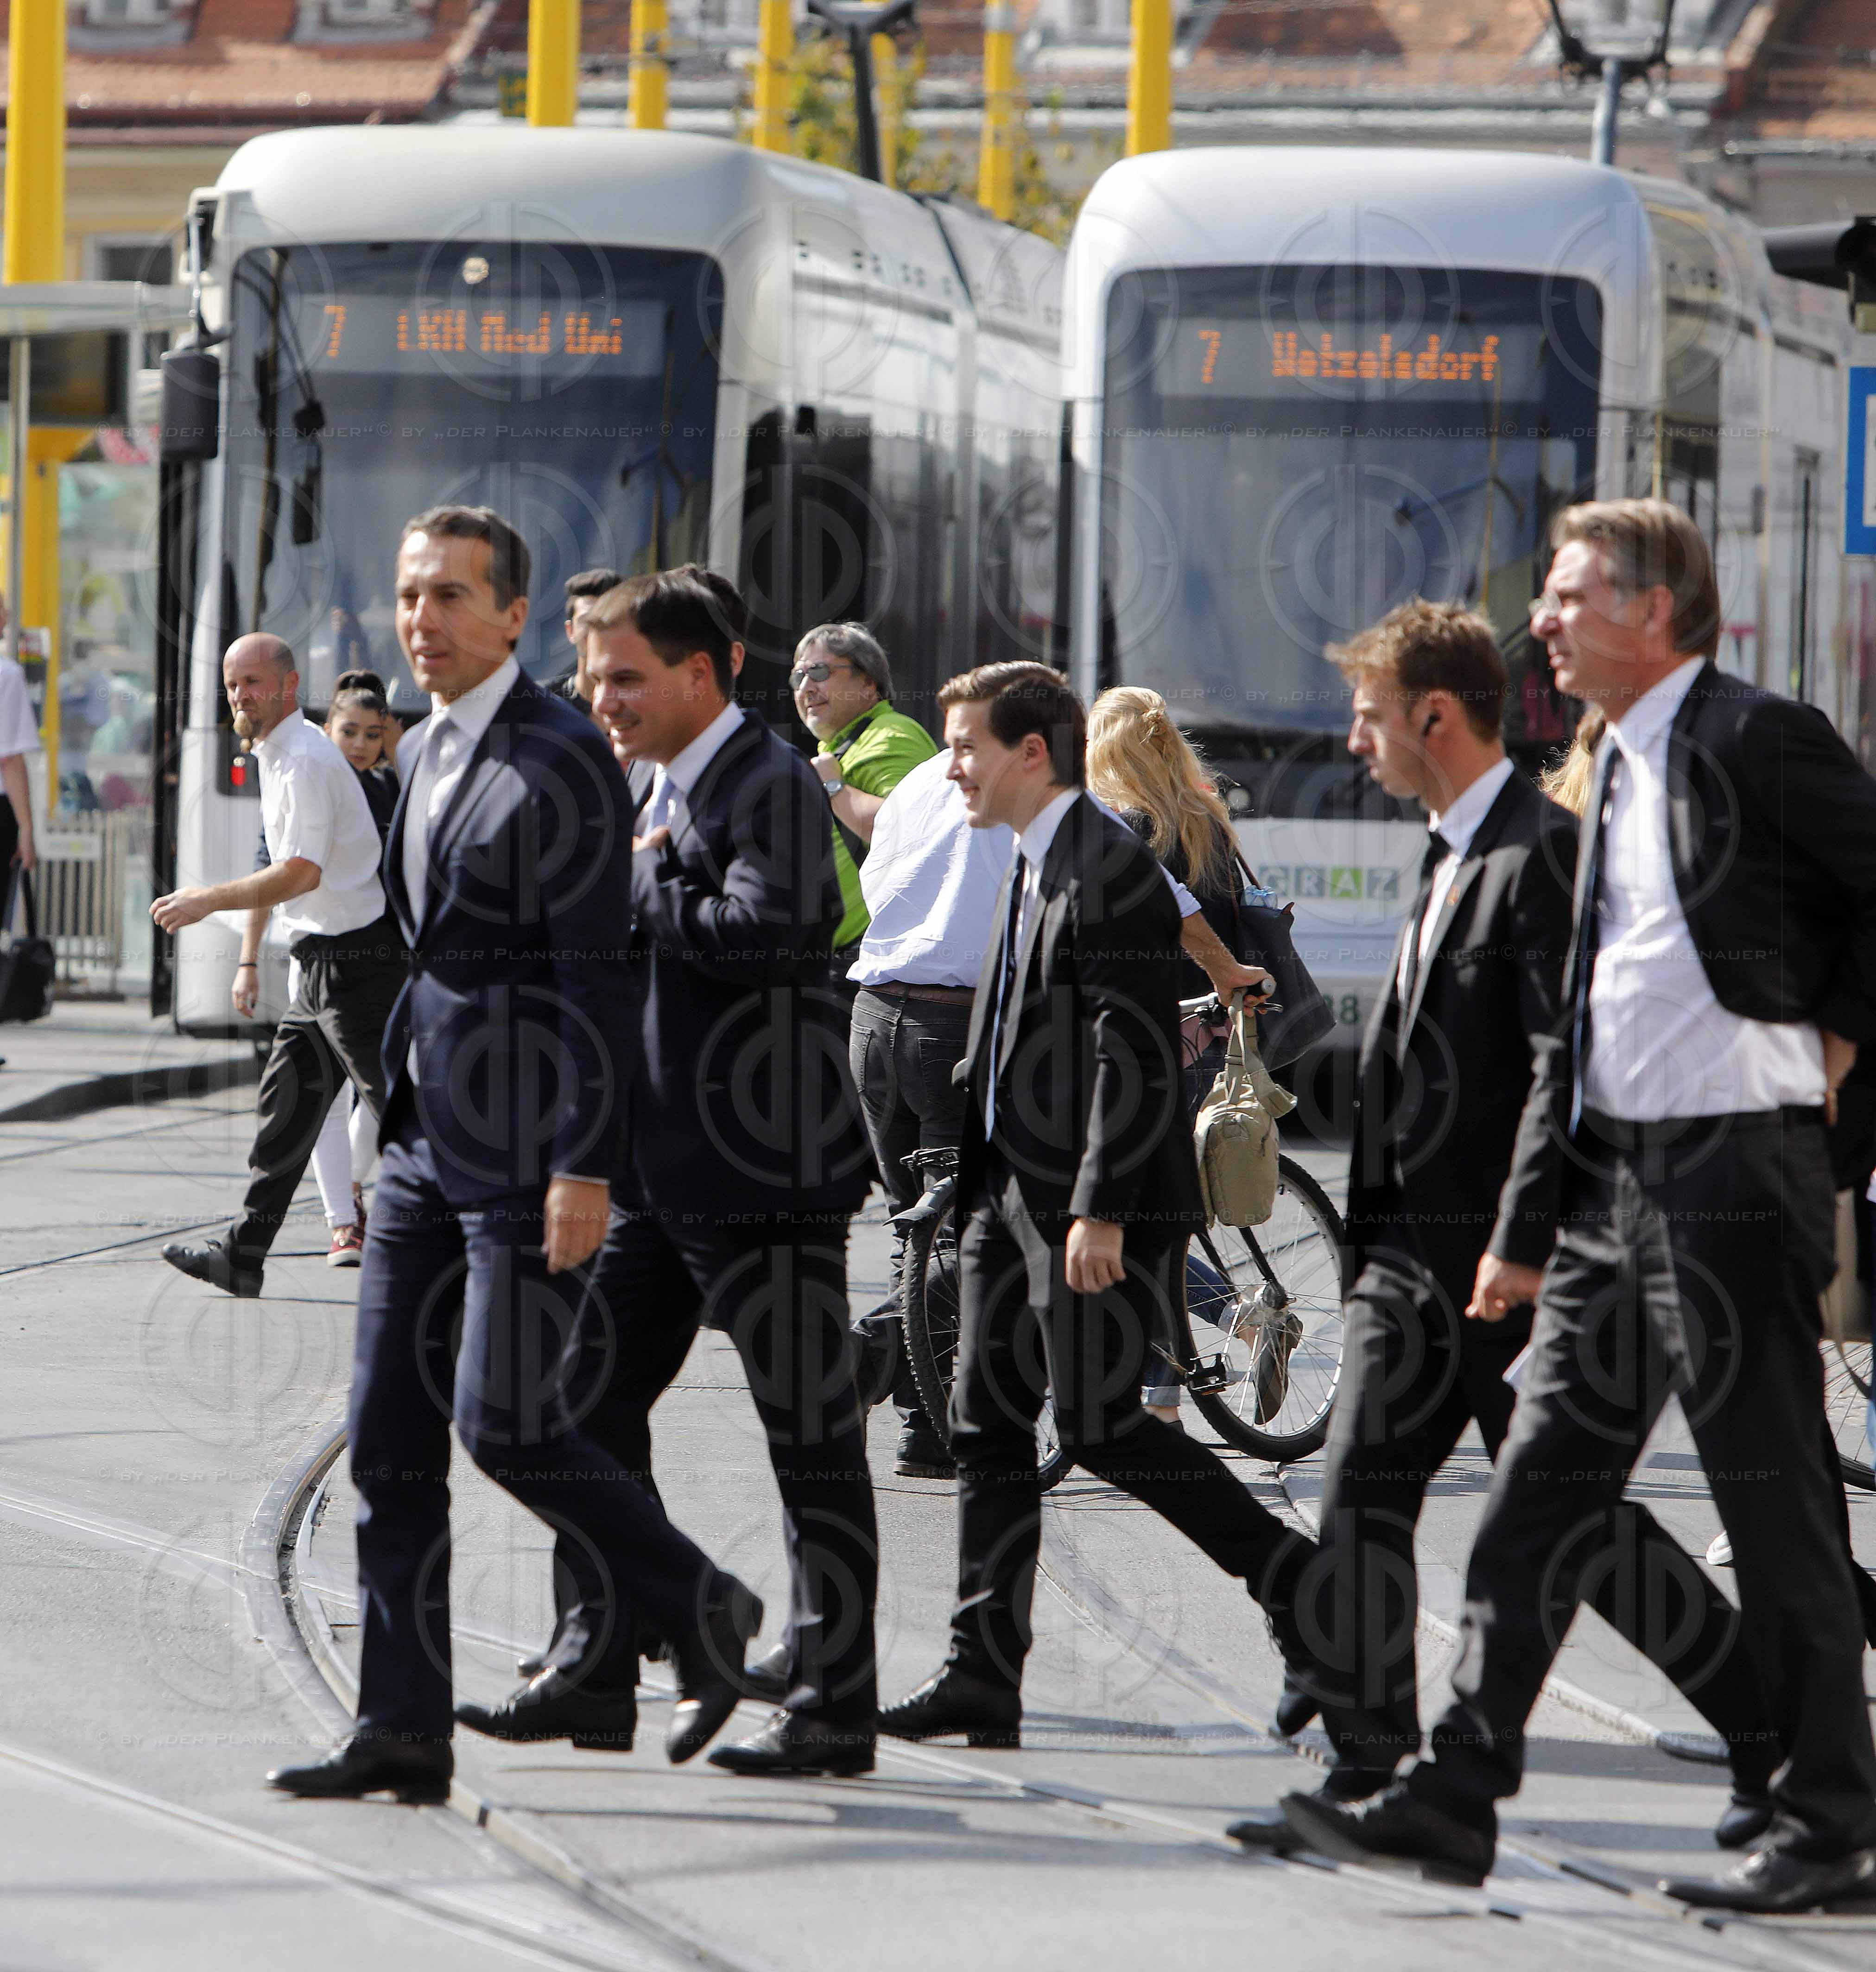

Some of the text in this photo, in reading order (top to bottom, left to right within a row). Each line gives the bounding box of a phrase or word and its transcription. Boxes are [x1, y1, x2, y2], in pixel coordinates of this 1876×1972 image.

[324, 305, 346, 358] 7
[481, 311, 551, 354] Med
[565, 312, 622, 355] Uni
[1198, 329, 1500, 383] 7 Wetzelsdorf
[1260, 866, 1399, 898] GRAZ
